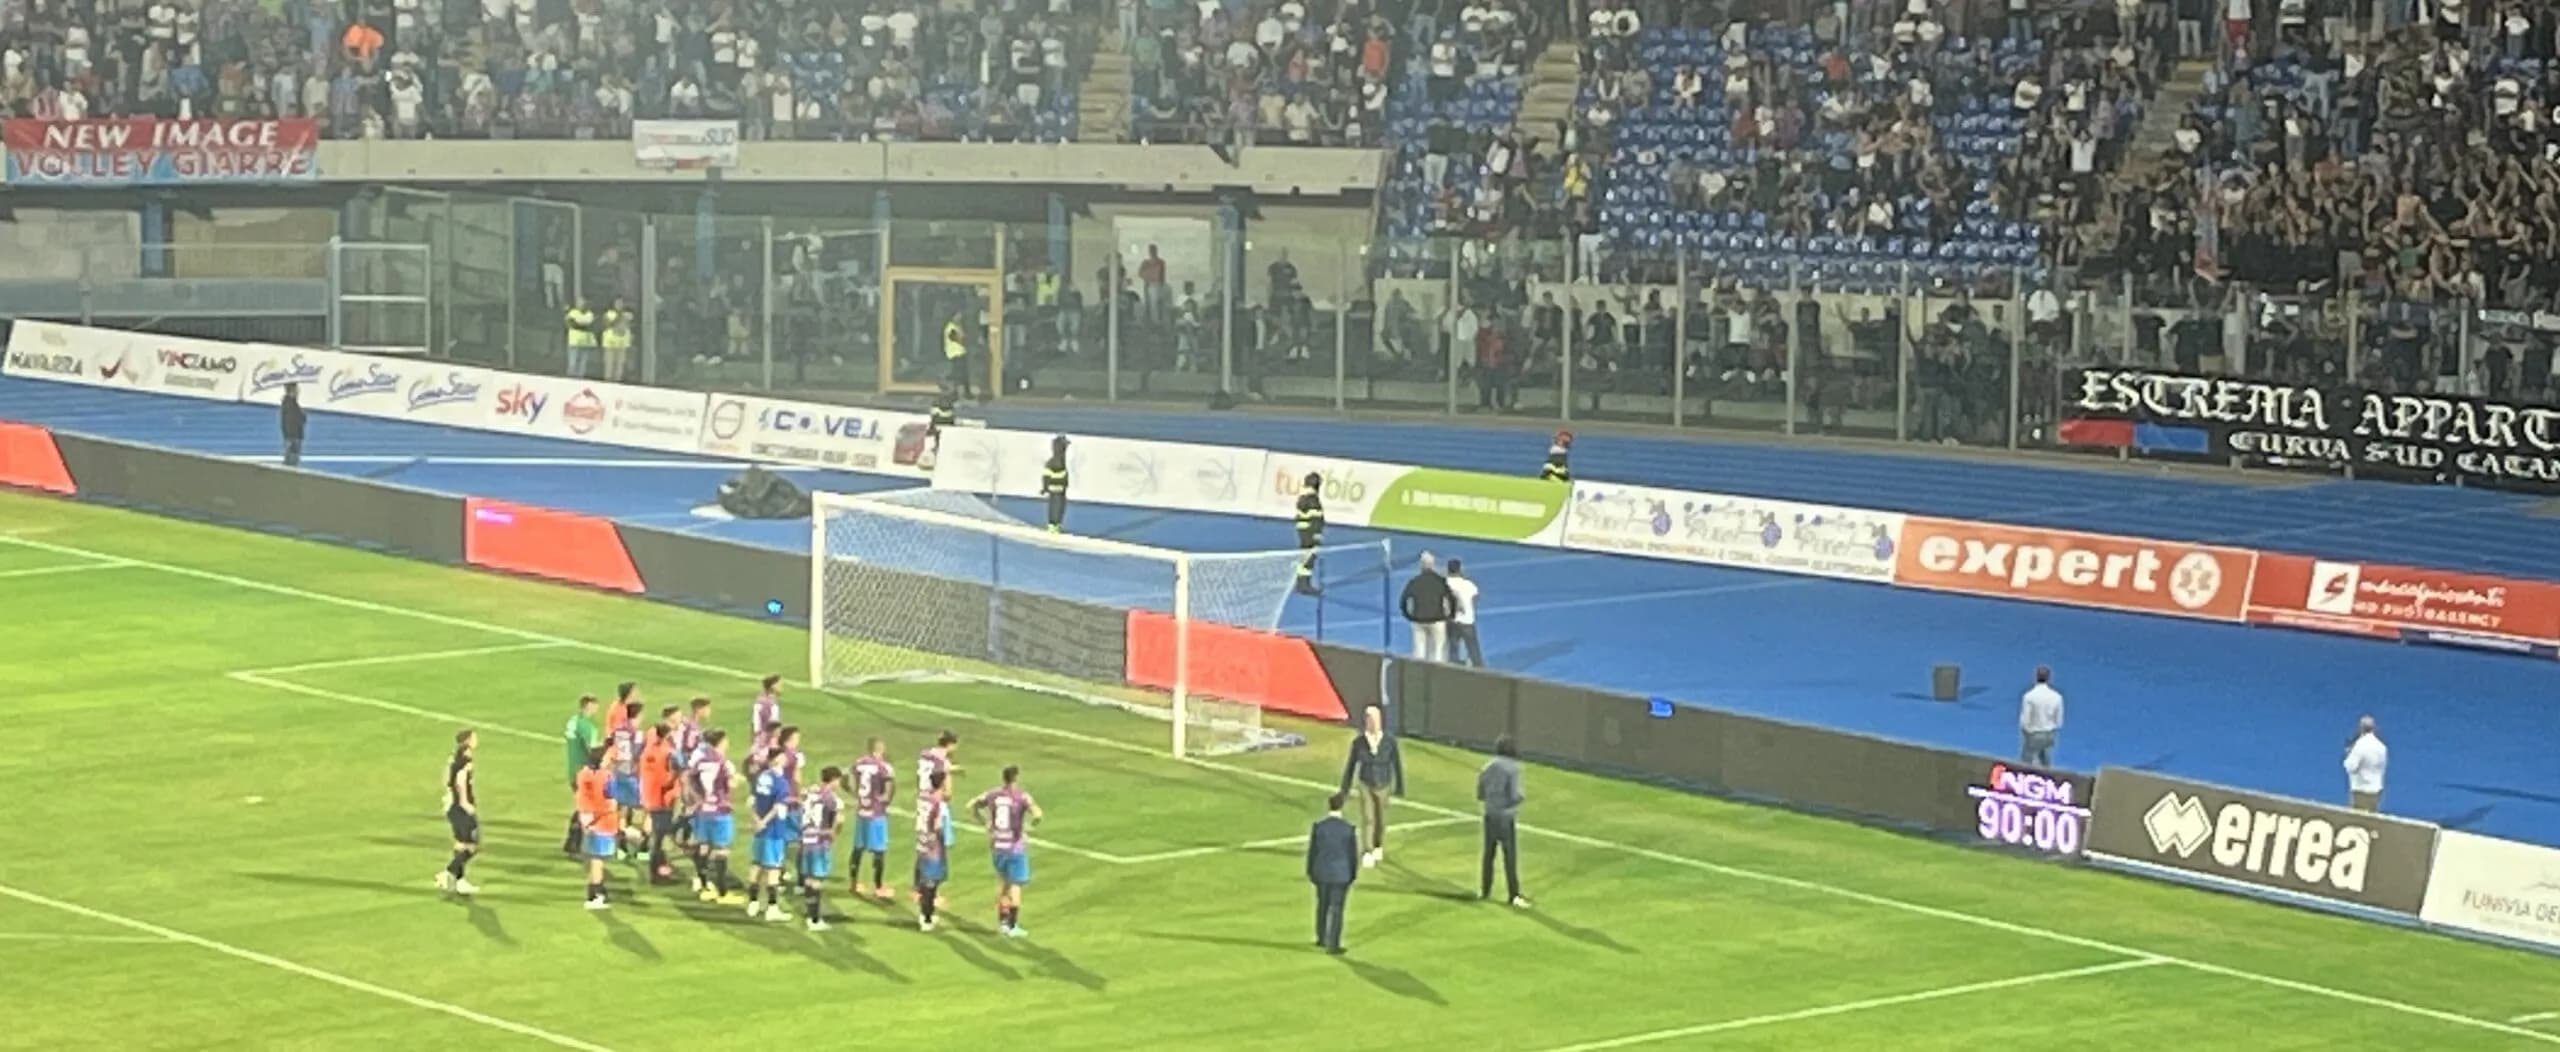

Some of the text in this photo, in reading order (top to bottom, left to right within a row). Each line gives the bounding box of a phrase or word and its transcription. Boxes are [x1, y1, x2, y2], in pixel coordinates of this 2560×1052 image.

[43, 120, 279, 149] NEW IMAGE
[17, 152, 152, 177] VOLLEY
[495, 383, 550, 426] sky
[2080, 370, 2330, 431] ESTREMA
[2229, 431, 2351, 460] CURVA
[2364, 441, 2444, 467] SUD
[1919, 535, 2162, 592] expert
[1978, 797, 2077, 854] 90:00
